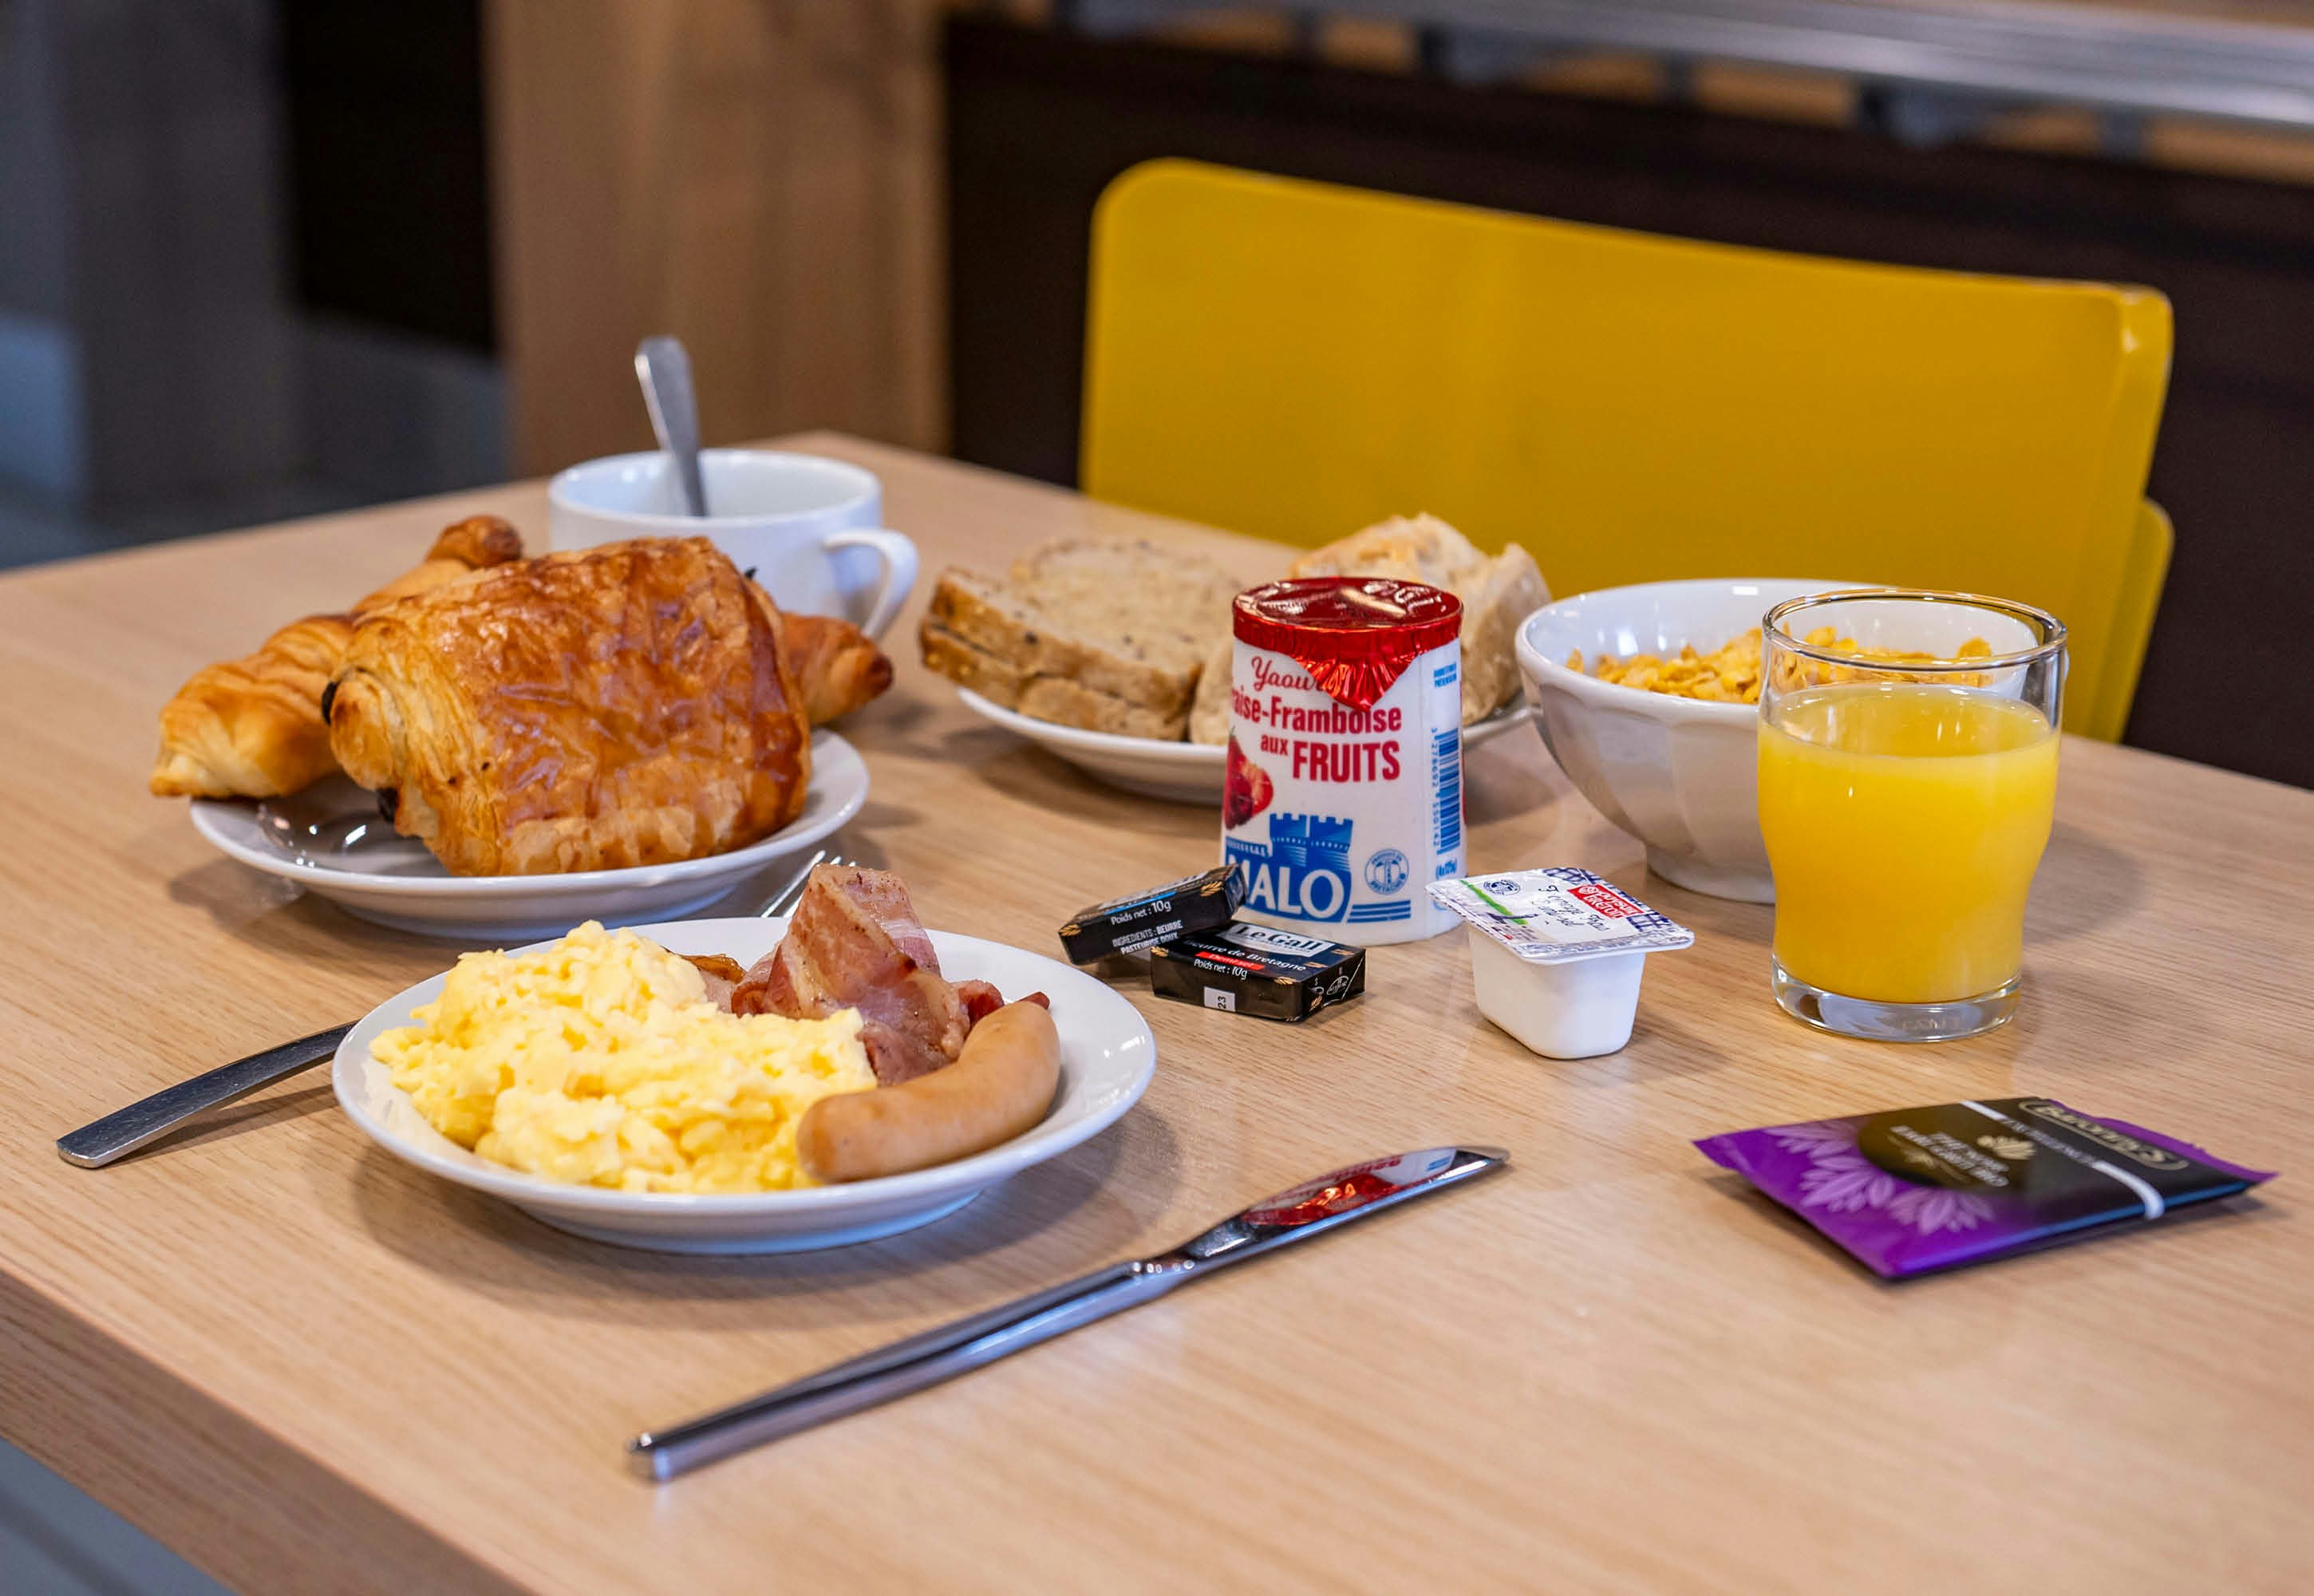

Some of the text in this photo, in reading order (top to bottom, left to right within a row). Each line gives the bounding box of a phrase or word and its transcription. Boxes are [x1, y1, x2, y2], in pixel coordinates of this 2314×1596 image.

[1260, 734, 1400, 783] aux FRUITS
[1111, 913, 1133, 925] Poids
[1134, 909, 1147, 918] net
[1151, 900, 1171, 916] 10g
[1267, 934, 1324, 951] Gall
[1194, 958, 1213, 970] Poids
[1214, 963, 1226, 974] net
[1232, 966, 1248, 981] 10g
[1228, 949, 1246, 958] de
[1246, 953, 1307, 972] Bretagne
[1217, 995, 1226, 1009] 23
